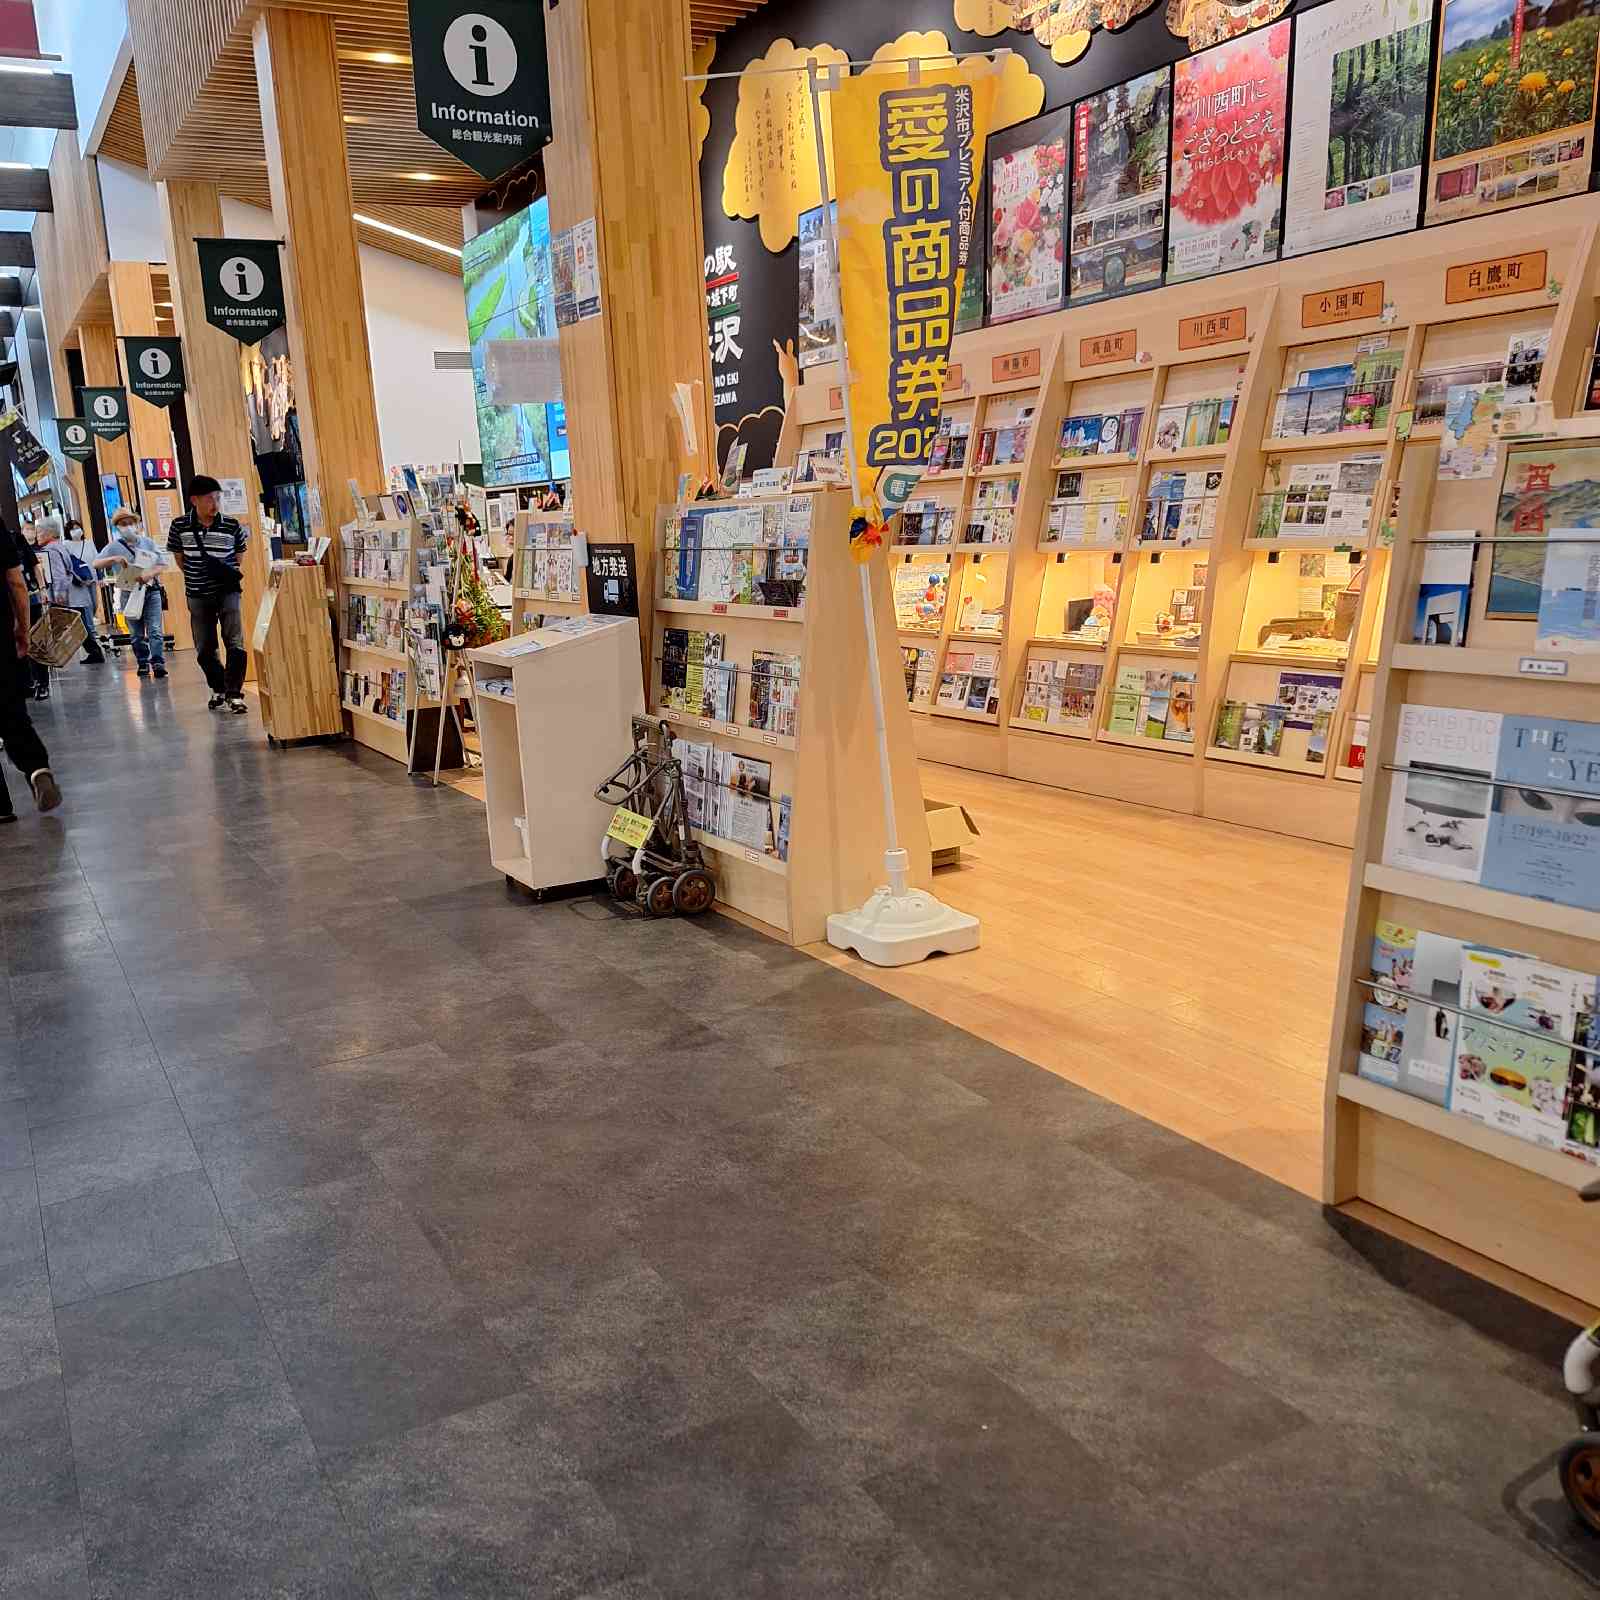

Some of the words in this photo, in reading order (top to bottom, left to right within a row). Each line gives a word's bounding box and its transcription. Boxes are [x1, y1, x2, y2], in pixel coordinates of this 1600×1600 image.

[431, 102, 539, 129] Information
[452, 128, 522, 145] 総合観光案内所
[705, 245, 737, 276] の駅
[886, 92, 951, 420] 愛の商品券
[214, 306, 278, 317] Information
[1320, 290, 1364, 312] 小国町
[1193, 317, 1230, 336] 川西町
[592, 556, 628, 577] 地方発送
[1513, 728, 1568, 753] THE
